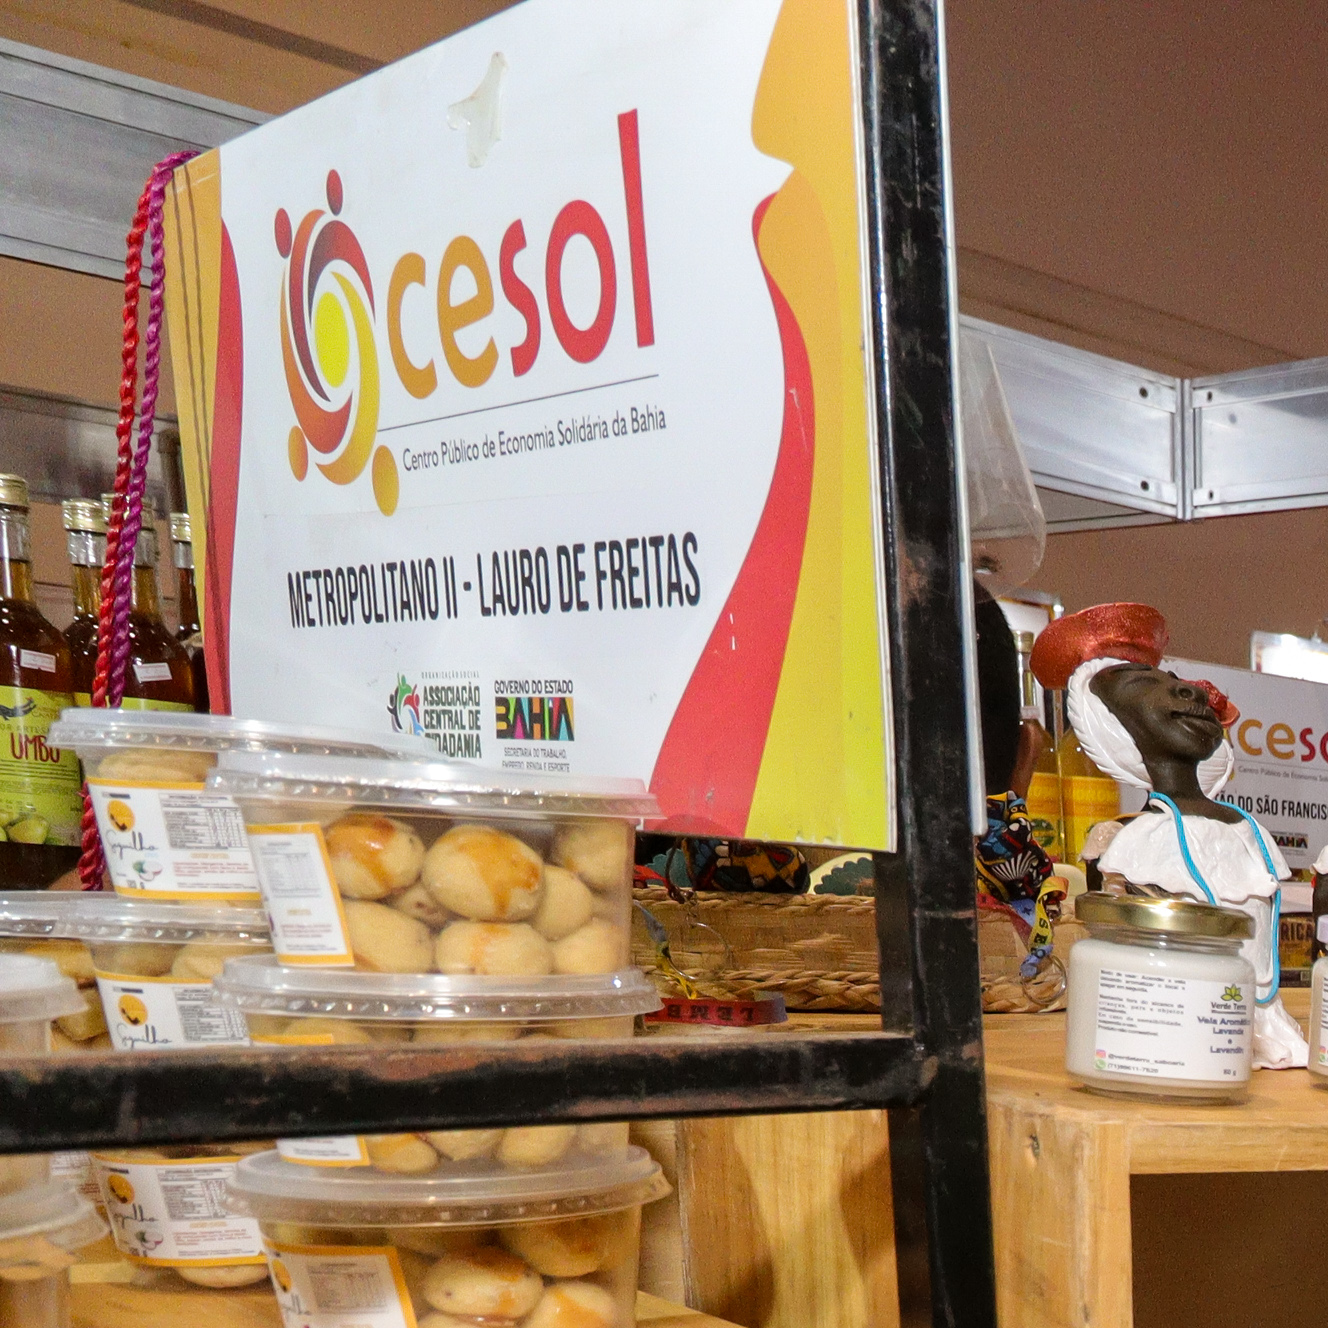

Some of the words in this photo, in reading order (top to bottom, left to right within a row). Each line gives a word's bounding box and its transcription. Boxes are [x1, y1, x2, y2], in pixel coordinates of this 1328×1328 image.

[386, 107, 656, 400] cesol
[403, 448, 439, 472] Centro
[441, 439, 479, 466] Público
[482, 435, 496, 459] de
[499, 425, 556, 456] Economia
[557, 415, 609, 446] Solidária
[612, 410, 628, 436] da
[630, 405, 667, 434] Bahia
[287, 556, 439, 628] METROPOLITANO
[442, 555, 458, 619] II
[463, 581, 472, 591] -
[477, 546, 551, 617] LAURO
[557, 543, 589, 614] DE
[594, 531, 701, 611] FREITAS
[423, 682, 480, 709] ASSOCIAÇÃO
[494, 680, 530, 694] GOVERNO
[531, 680, 543, 694] DO
[544, 680, 573, 694] ESTADO
[424, 709, 466, 730] CENTRAL
[469, 710, 481, 730] DE
[495, 697, 575, 741] BAHIA
[1257, 795, 1278, 815] SÃO
[1211, 1002, 1231, 1010] Verde
[1197, 1016, 1217, 1025] Vela
